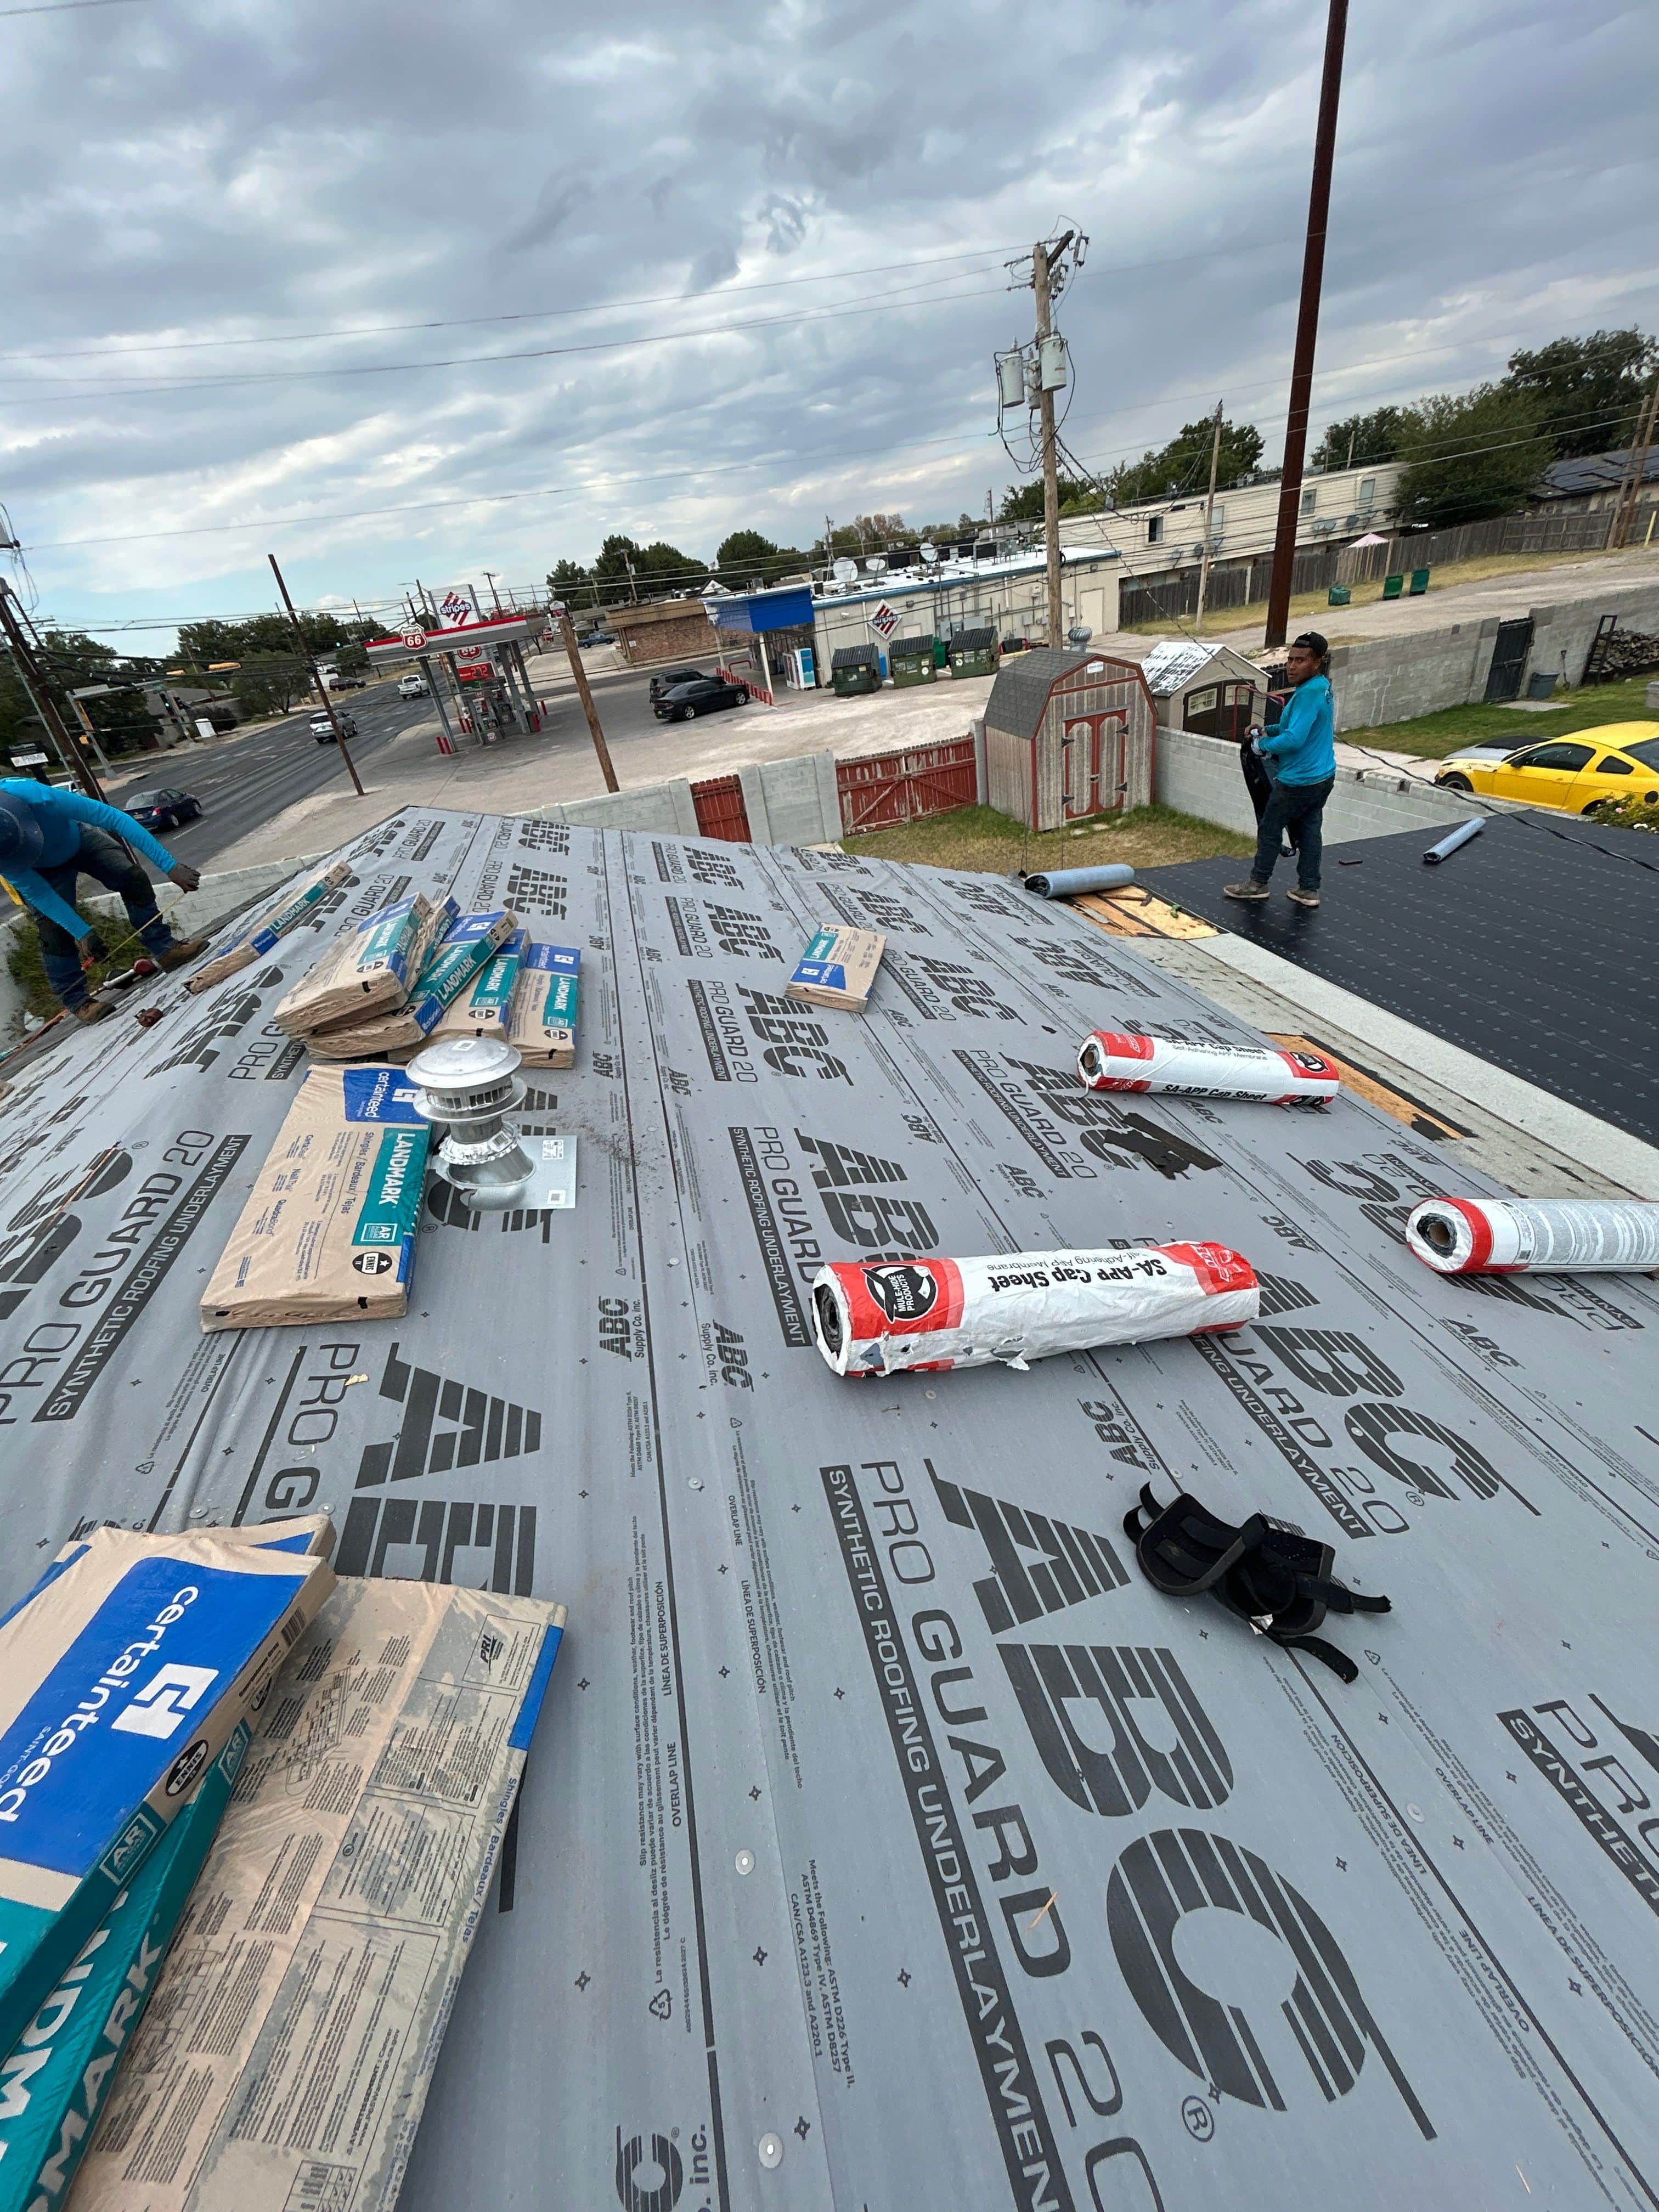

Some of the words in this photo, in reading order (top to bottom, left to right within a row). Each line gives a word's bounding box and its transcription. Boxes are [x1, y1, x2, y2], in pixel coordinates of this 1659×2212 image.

[440, 602, 472, 615] stripes
[407, 635, 422, 647] 66
[351, 884, 386, 919] GUARD
[374, 873, 394, 884] 20
[476, 874, 499, 901] GUARD
[503, 862, 568, 921] ABC
[273, 898, 311, 930] LANDMARK
[685, 913, 708, 944] GUARD
[702, 899, 786, 964] ABC
[432, 944, 465, 984] LANDMARK
[645, 946, 663, 963] ABC
[695, 945, 714, 958] 20
[809, 939, 830, 960] LANDMARK
[438, 954, 476, 1001] LANDMARK
[485, 958, 507, 992] LANDMARK
[706, 980, 730, 1005] PRO
[904, 950, 1029, 1026] ABC
[553, 977, 571, 1011] LANDMARK
[900, 967, 941, 1003] GUARD
[931, 1005, 957, 1021] 20
[715, 1006, 749, 1057] GUARD
[735, 983, 854, 1086] ABC
[888, 1009, 916, 1029] ABC
[227, 1042, 279, 1080] PRO
[592, 1051, 614, 1080] ABC
[706, 1029, 728, 1081] UNDERLAYMENT
[732, 1061, 759, 1083] 20
[365, 1071, 390, 1119] certainteed
[667, 1066, 691, 1097] ABC
[1162, 1084, 1209, 1096] SA-APP
[1209, 1088, 1232, 1098] Cap
[1232, 1090, 1267, 1101] Sheet
[900, 1113, 938, 1145] ABC
[969, 1049, 1008, 1078] PRO
[999, 1082, 1067, 1145] GUARD
[1058, 1152, 1098, 1178] 20
[1184, 1098, 1227, 1125] ABC
[364, 1131, 375, 1155] Shingles
[983, 1082, 1011, 1111] ROOFING
[1008, 1109, 1069, 1178] UNDERLAYMENT
[753, 1126, 791, 1171] PRO
[1361, 1153, 1406, 1178] 20
[349, 1161, 366, 1193] Bardeaux
[377, 1132, 416, 1206] LANDMARK
[1002, 1162, 1048, 1200] ABC
[59, 1172, 184, 1309] GUARD
[162, 1130, 216, 1167] 20
[341, 1197, 356, 1215] Tejas
[379, 1226, 392, 1239] AR
[733, 1128, 757, 1178] SYNTHETIC
[747, 1178, 771, 1227] ROOFING
[761, 1229, 806, 1344] UNDERLAYMENT
[771, 1178, 825, 1284] GUARD
[1257, 1214, 1320, 1254] ABC
[46, 1305, 133, 1417] SYNTHETIC
[132, 1233, 179, 1302] ROOFING
[173, 1136, 247, 1235] UNDERLAYMENT
[365, 1256, 376, 1271] ENNIS
[986, 1257, 1047, 1274] Membrane
[988, 1269, 1047, 1293] Sheet
[1051, 1263, 1091, 1286] Cap
[1096, 1257, 1166, 1282] SA-APP
[888, 1273, 906, 1313] MULE-HIDE
[896, 1273, 915, 1312] PRODUCTS
[598, 1294, 633, 1363] ABC
[633, 1313, 643, 1328] Co.
[700, 1322, 714, 1352] Supply
[634, 1328, 645, 1359] Supply
[706, 1353, 716, 1368] Co.
[712, 1318, 755, 1393] ABC
[1442, 1316, 1526, 1370] ABC
[198, 1364, 222, 1394] OVERLAP
[212, 1350, 227, 1367] LINE
[286, 1342, 362, 1447] PRO
[1249, 1268, 1542, 1517] ABC
[1077, 1397, 1153, 1475] ABC
[1132, 1434, 1160, 1471] Supply
[1228, 1376, 1369, 1533] UNDERLAYMENT
[727, 1494, 740, 1528] OVERLAP
[1329, 1466, 1410, 1534] 20
[732, 1529, 743, 1546] LINE
[626, 1576, 634, 1590] pitch
[741, 1579, 753, 1604] LÍNEA
[653, 1581, 667, 1651] SUPERPOSICIÓN
[744, 1605, 754, 1617] DE
[828, 1468, 884, 1612] SYNTHETIC
[870, 1620, 932, 1774] ROOFING
[479, 1634, 494, 1663] PRI
[659, 1652, 668, 1666] DE
[747, 1618, 768, 1694] SUPERPOSICIÓN
[630, 1674, 641, 1713] conditions,
[659, 1666, 672, 1696] LÍNEA
[0, 1585, 199, 1822] certainteed
[633, 1714, 641, 1742] surface
[174, 1751, 202, 1786] ENNIS
[225, 1729, 244, 1772] AR
[666, 1742, 676, 1768] LINE
[636, 1762, 645, 1779] vary
[1330, 1730, 1391, 1822] SUPERPOSICIÓN
[495, 1774, 517, 1825] Shingles
[637, 1781, 646, 1799] may
[669, 1769, 682, 1825] OVERLAP
[923, 1458, 1438, 2142] ABC
[1432, 1765, 1476, 1820] OVERLAP
[1470, 1817, 1495, 1847] LINE
[637, 1801, 646, 1846] resistance
[860, 1459, 936, 1585] PRO
[910, 1608, 1072, 1979] GUARD
[1043, 2029, 1165, 2212] 20
[1387, 1821, 1404, 1841] DE
[113, 1824, 145, 1867] AR
[639, 1847, 648, 1866] Slip
[1398, 1838, 1425, 1873] LÍNEA
[475, 1834, 500, 1898] Bardeaux
[806, 1859, 820, 1888] Meets
[801, 1873, 813, 1904] ASTM
[812, 1891, 823, 1909] the
[461, 1909, 478, 1944] Tejas
[789, 1892, 805, 1945] CAN/CSA
[805, 1905, 819, 1942] D4869
[1526, 1894, 1560, 1936] LÍNEA
[1556, 1934, 1574, 1956] DE
[814, 1910, 834, 1967] Following:
[1457, 1927, 1485, 1962] LINE
[798, 1946, 811, 1987] A123.3
[811, 1943, 823, 1973] Type
[816, 1973, 826, 1991] IV,
[826, 1968, 840, 2004] ASTM
[1477, 1960, 1533, 2034] OVERLAP
[804, 1989, 815, 2012] and
[820, 1993, 833, 2029] ASTM
[809, 2013, 823, 2058] A220.1
[832, 2005, 848, 2040] D226
[826, 2031, 841, 2074] D8257
[838, 2041, 851, 2068] Type
